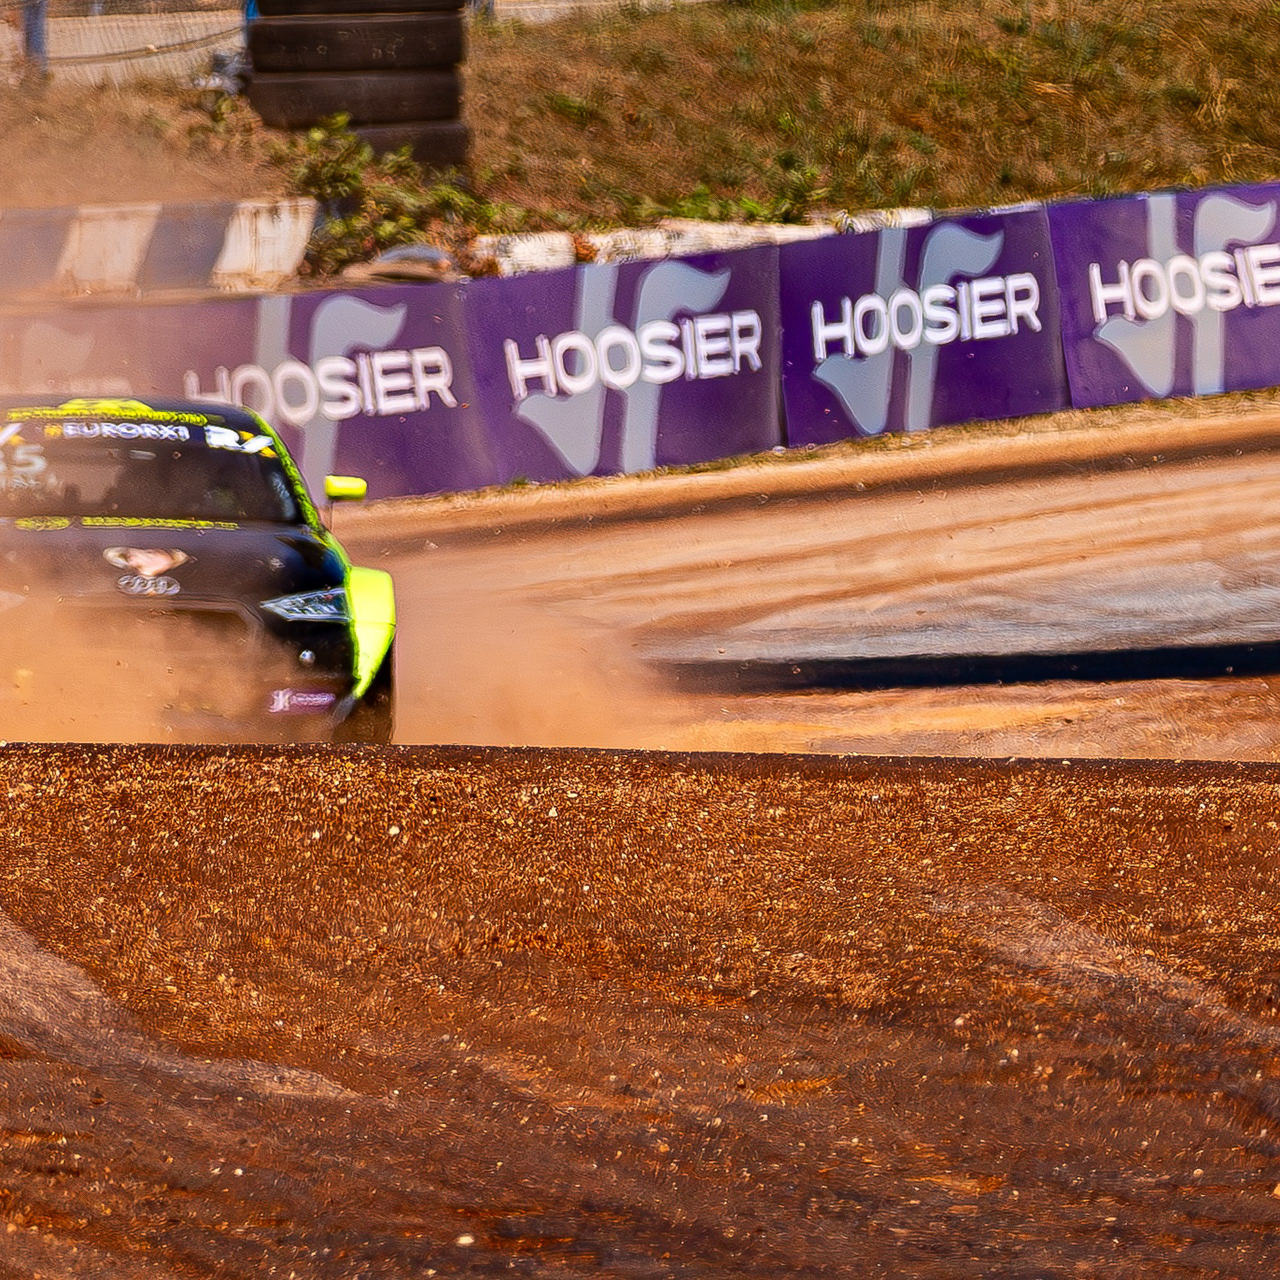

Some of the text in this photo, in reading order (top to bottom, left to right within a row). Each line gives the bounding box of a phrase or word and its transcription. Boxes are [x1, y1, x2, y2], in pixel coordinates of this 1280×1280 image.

[503, 309, 762, 400] HOOSIER
[810, 272, 1042, 362] HOOSIER
[183, 346, 458, 426] HOOSIER
[43, 422, 190, 442] #EURORX1
